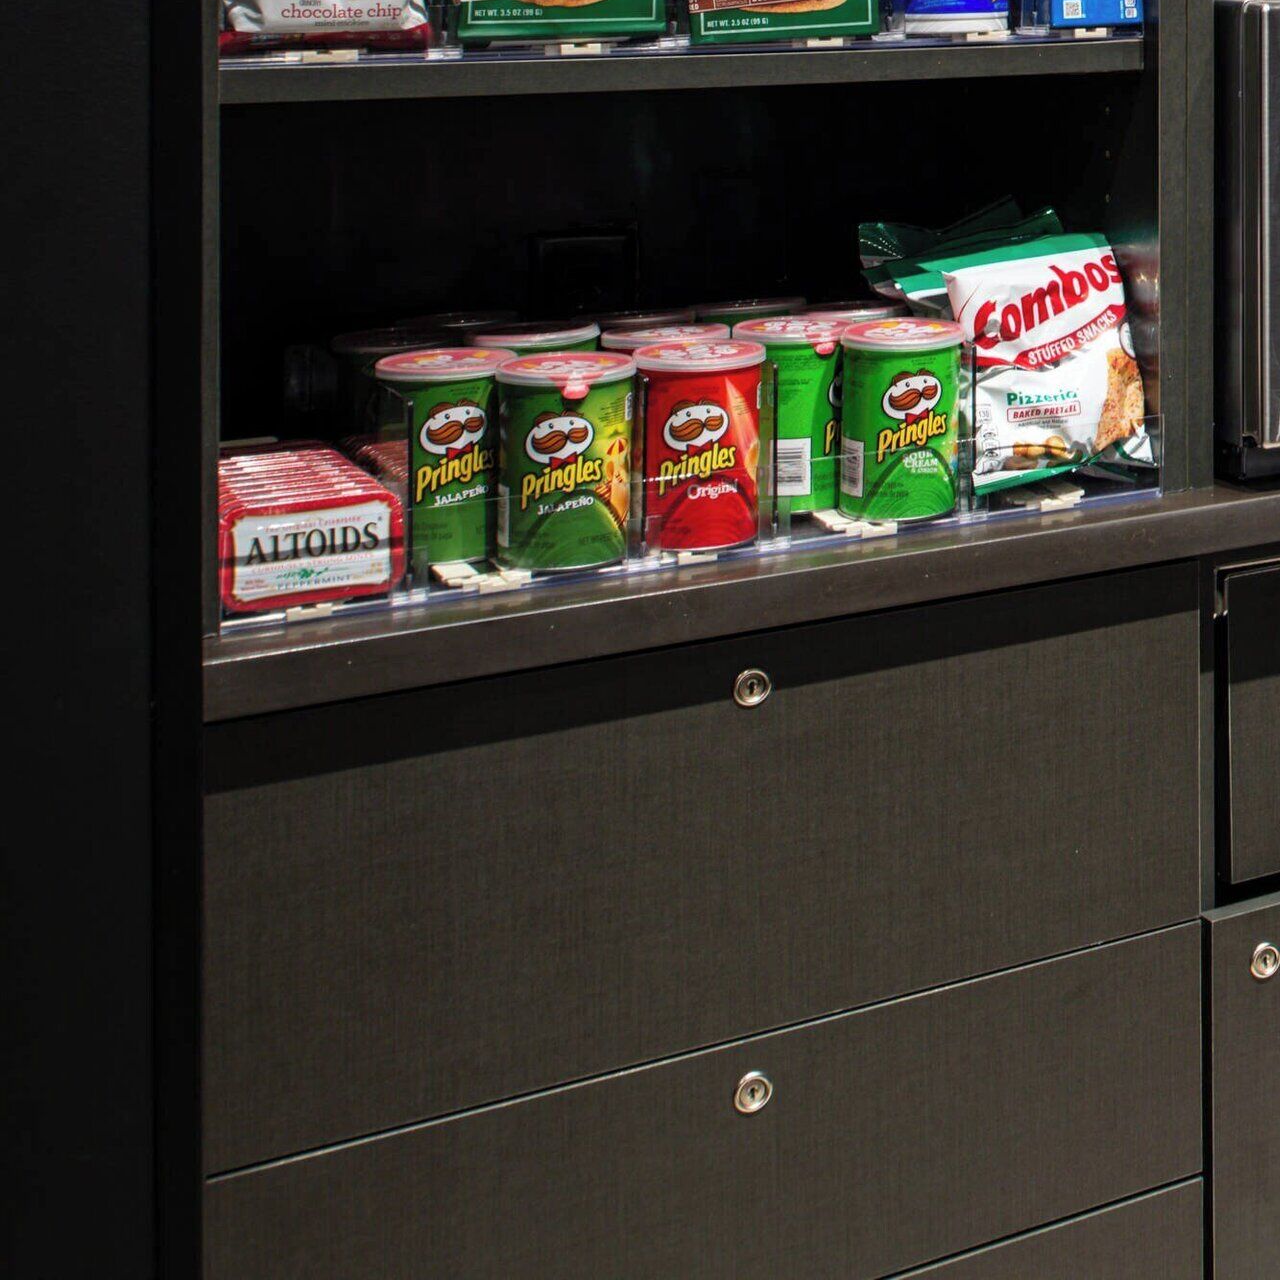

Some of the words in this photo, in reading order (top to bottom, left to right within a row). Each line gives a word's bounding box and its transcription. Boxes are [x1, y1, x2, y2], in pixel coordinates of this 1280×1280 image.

[281, 3, 363, 19] chocolate
[367, 2, 402, 21] chip
[474, 8, 487, 17] NET
[500, 8, 512, 17] 3.5
[512, 8, 522, 17] OZ
[706, 19, 718, 28] NET
[740, 18, 750, 26] OZ
[973, 253, 1123, 349] Combos
[1027, 337, 1076, 366] STUFFED
[1077, 310, 1117, 344] SNACKS
[1006, 387, 1078, 406] Pizzeria
[1012, 407, 1042, 419] BAKED
[876, 411, 948, 464] Pringles
[415, 444, 495, 504] Pringles
[658, 444, 737, 496] Pringles
[903, 458, 938, 468] CREAM
[521, 454, 604, 510] Pringles
[686, 478, 739, 500] Original
[246, 521, 380, 566] ALTOIDS
